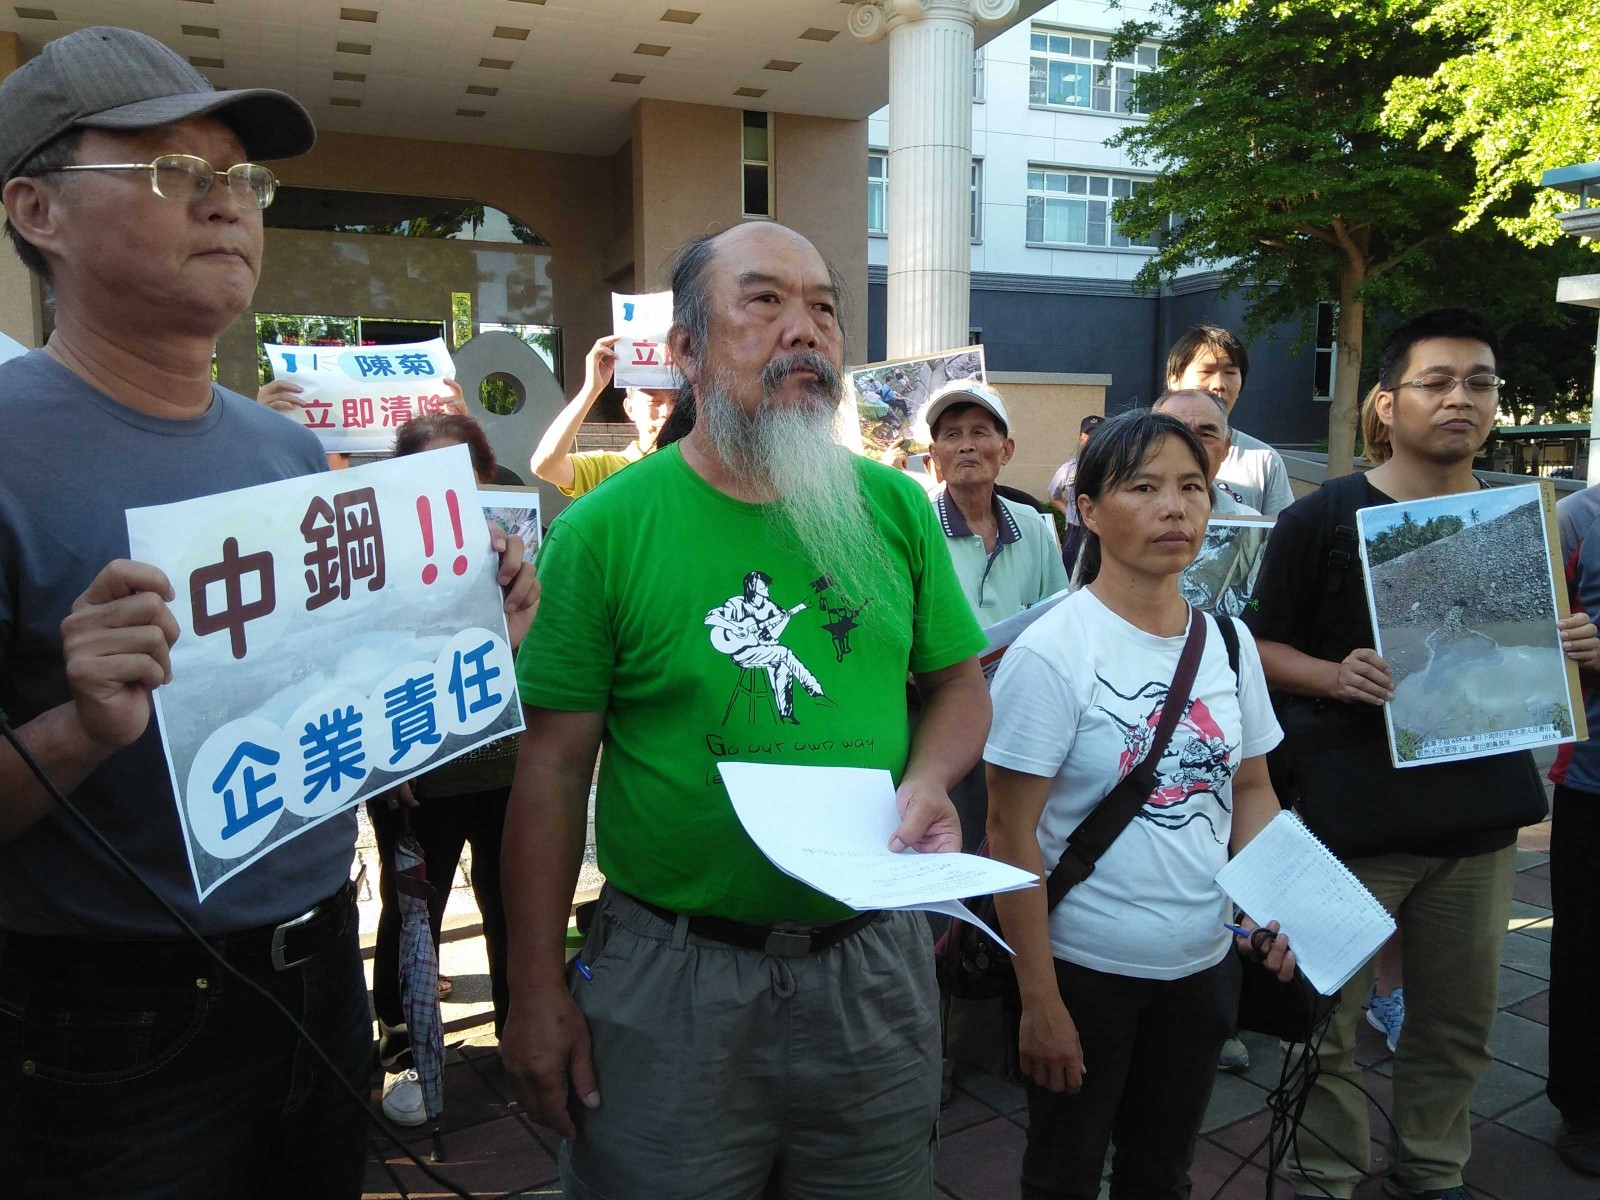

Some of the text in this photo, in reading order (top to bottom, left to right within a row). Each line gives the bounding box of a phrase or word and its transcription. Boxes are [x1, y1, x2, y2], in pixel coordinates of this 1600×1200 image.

[354, 353, 435, 378] 陳菊
[213, 640, 502, 840] 企業責任
[706, 734, 875, 757] Go our own way
